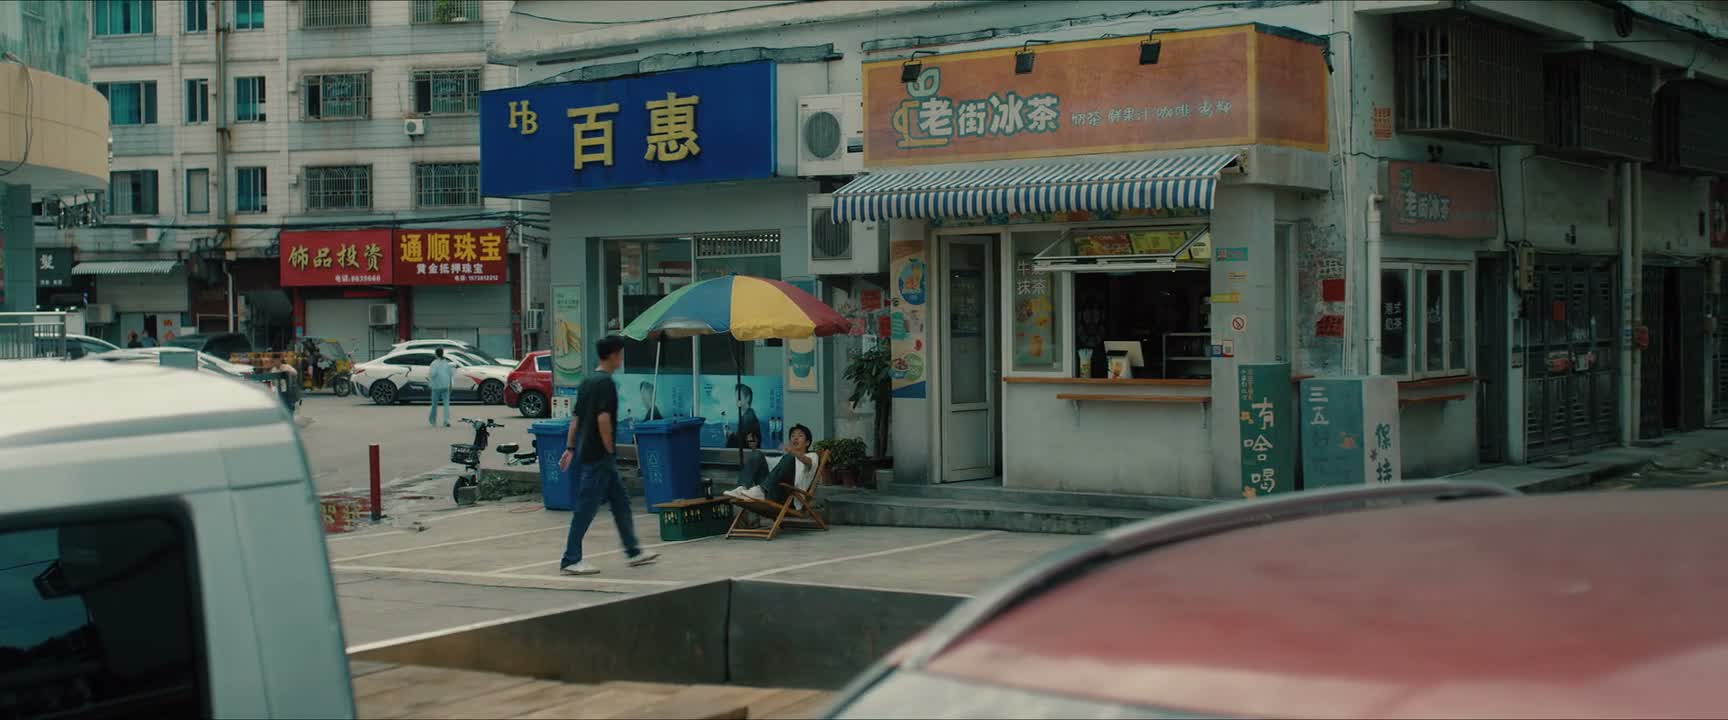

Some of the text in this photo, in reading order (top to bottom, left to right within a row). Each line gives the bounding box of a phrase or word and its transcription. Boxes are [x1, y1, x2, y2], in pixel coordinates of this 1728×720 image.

[567, 91, 701, 170] 百惠
[917, 92, 1060, 138] 老街冰茶
[288, 243, 384, 272] 饰品投资
[399, 232, 503, 263] 通顺珠宝
[416, 263, 484, 275] 黄金抵押珠宝
[1016, 279, 1046, 295] 抹茶
[1243, 396, 1275, 493] 有啥喝
